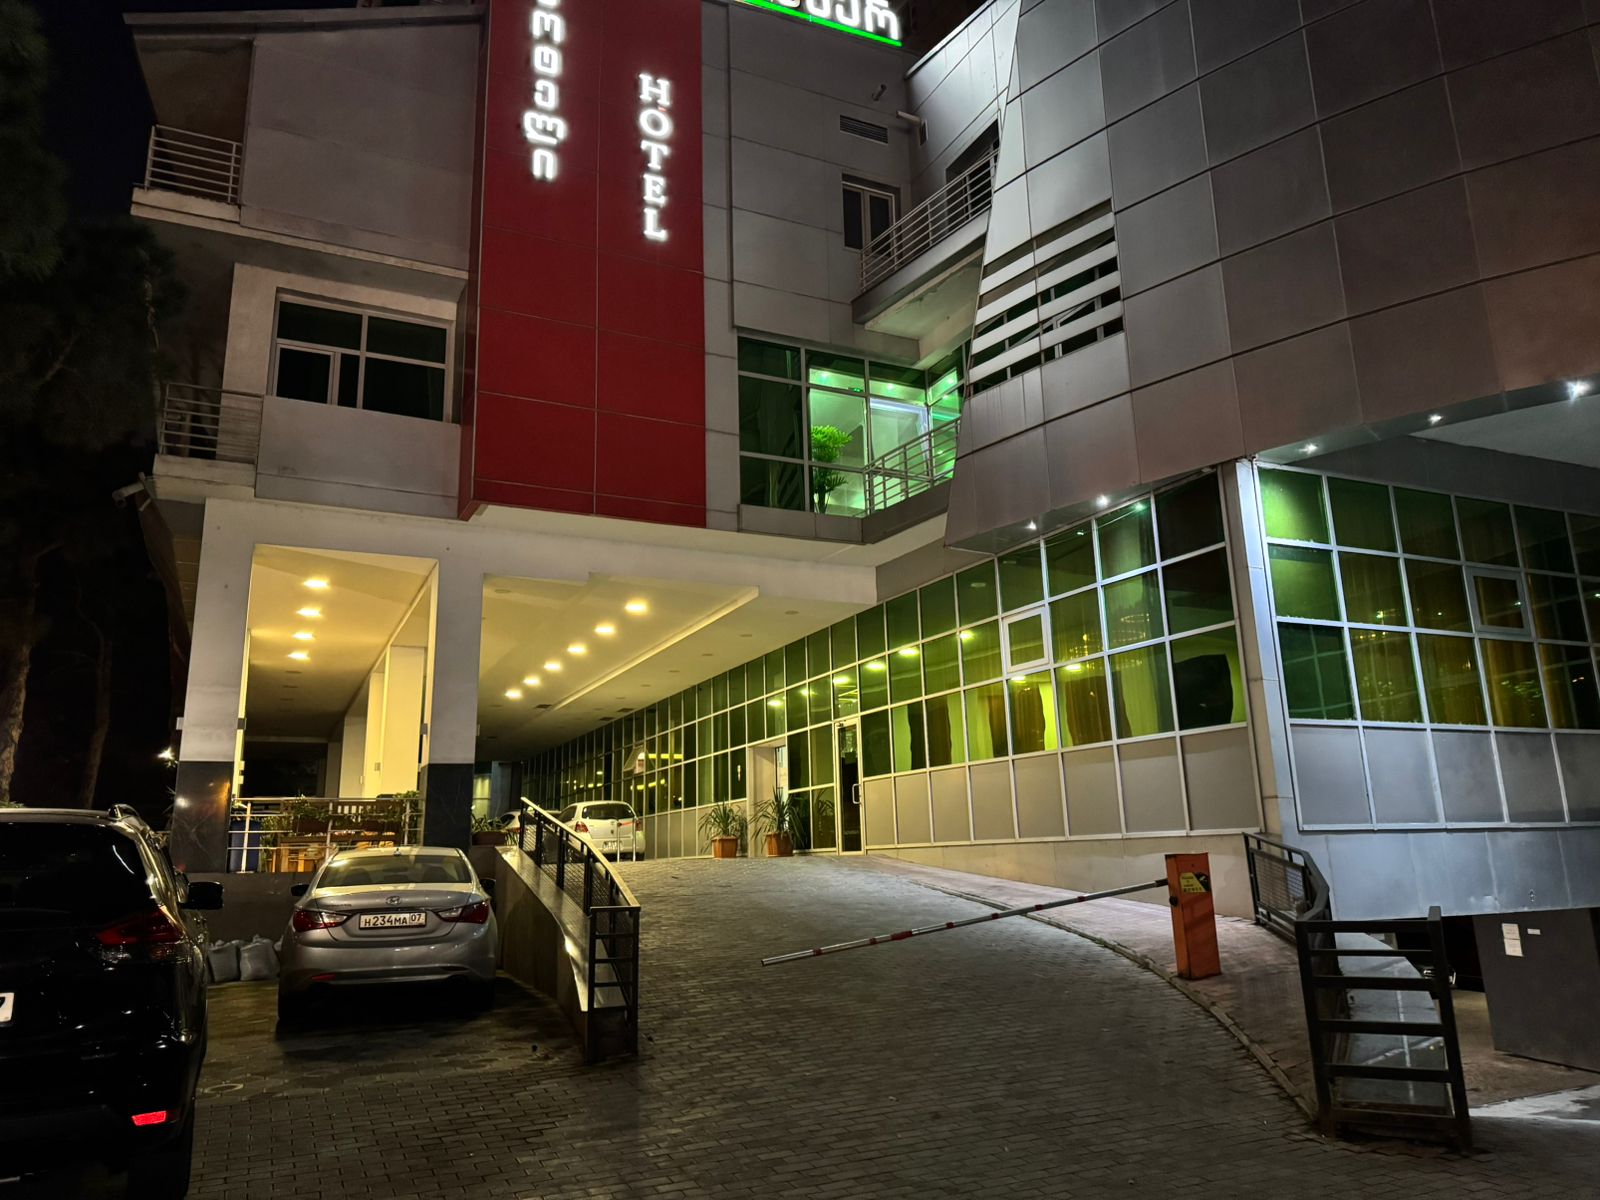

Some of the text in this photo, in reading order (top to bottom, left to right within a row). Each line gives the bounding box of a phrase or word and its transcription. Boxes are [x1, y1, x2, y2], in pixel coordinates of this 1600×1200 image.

[523, 0, 566, 180] ოტელი
[638, 73, 671, 241] HOTEL
[410, 913, 422, 922] 07
